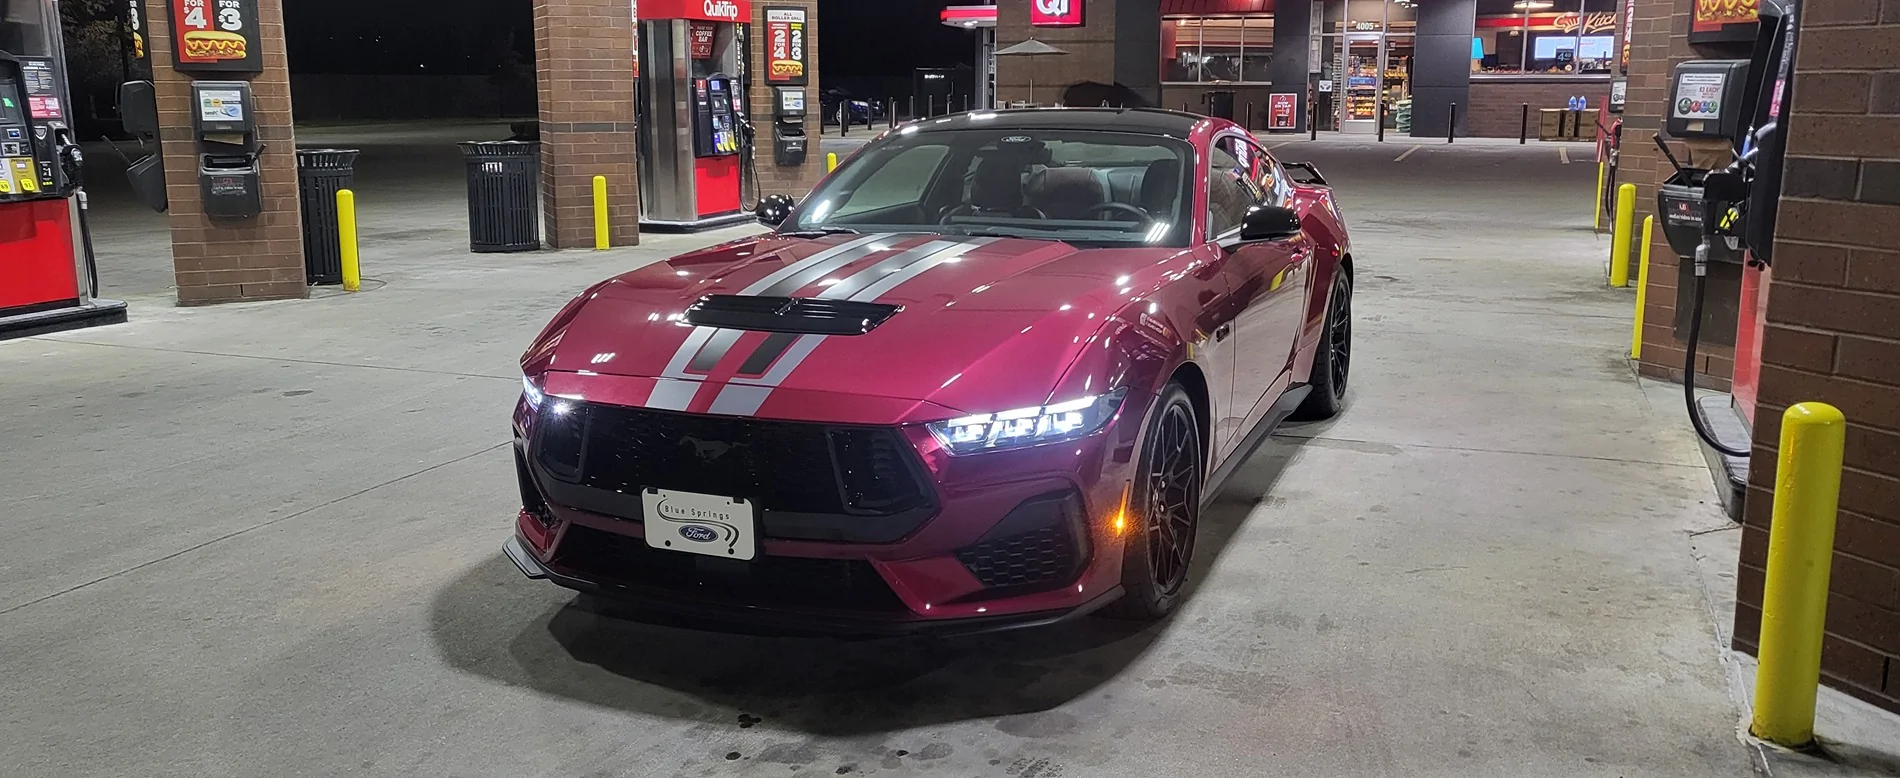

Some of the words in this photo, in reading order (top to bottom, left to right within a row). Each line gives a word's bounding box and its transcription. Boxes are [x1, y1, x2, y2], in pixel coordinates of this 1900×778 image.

[218, 1, 240, 9] FOR
[703, 0, 738, 20] QuikTrip
[184, 7, 207, 28] $4
[218, 8, 242, 31] $3
[1356, 22, 1374, 30] 4005
[773, 30, 786, 43] 2
[791, 30, 802, 43] 2
[664, 505, 686, 514] Blue
[691, 508, 730, 521] Springs
[686, 528, 711, 540] Ford
